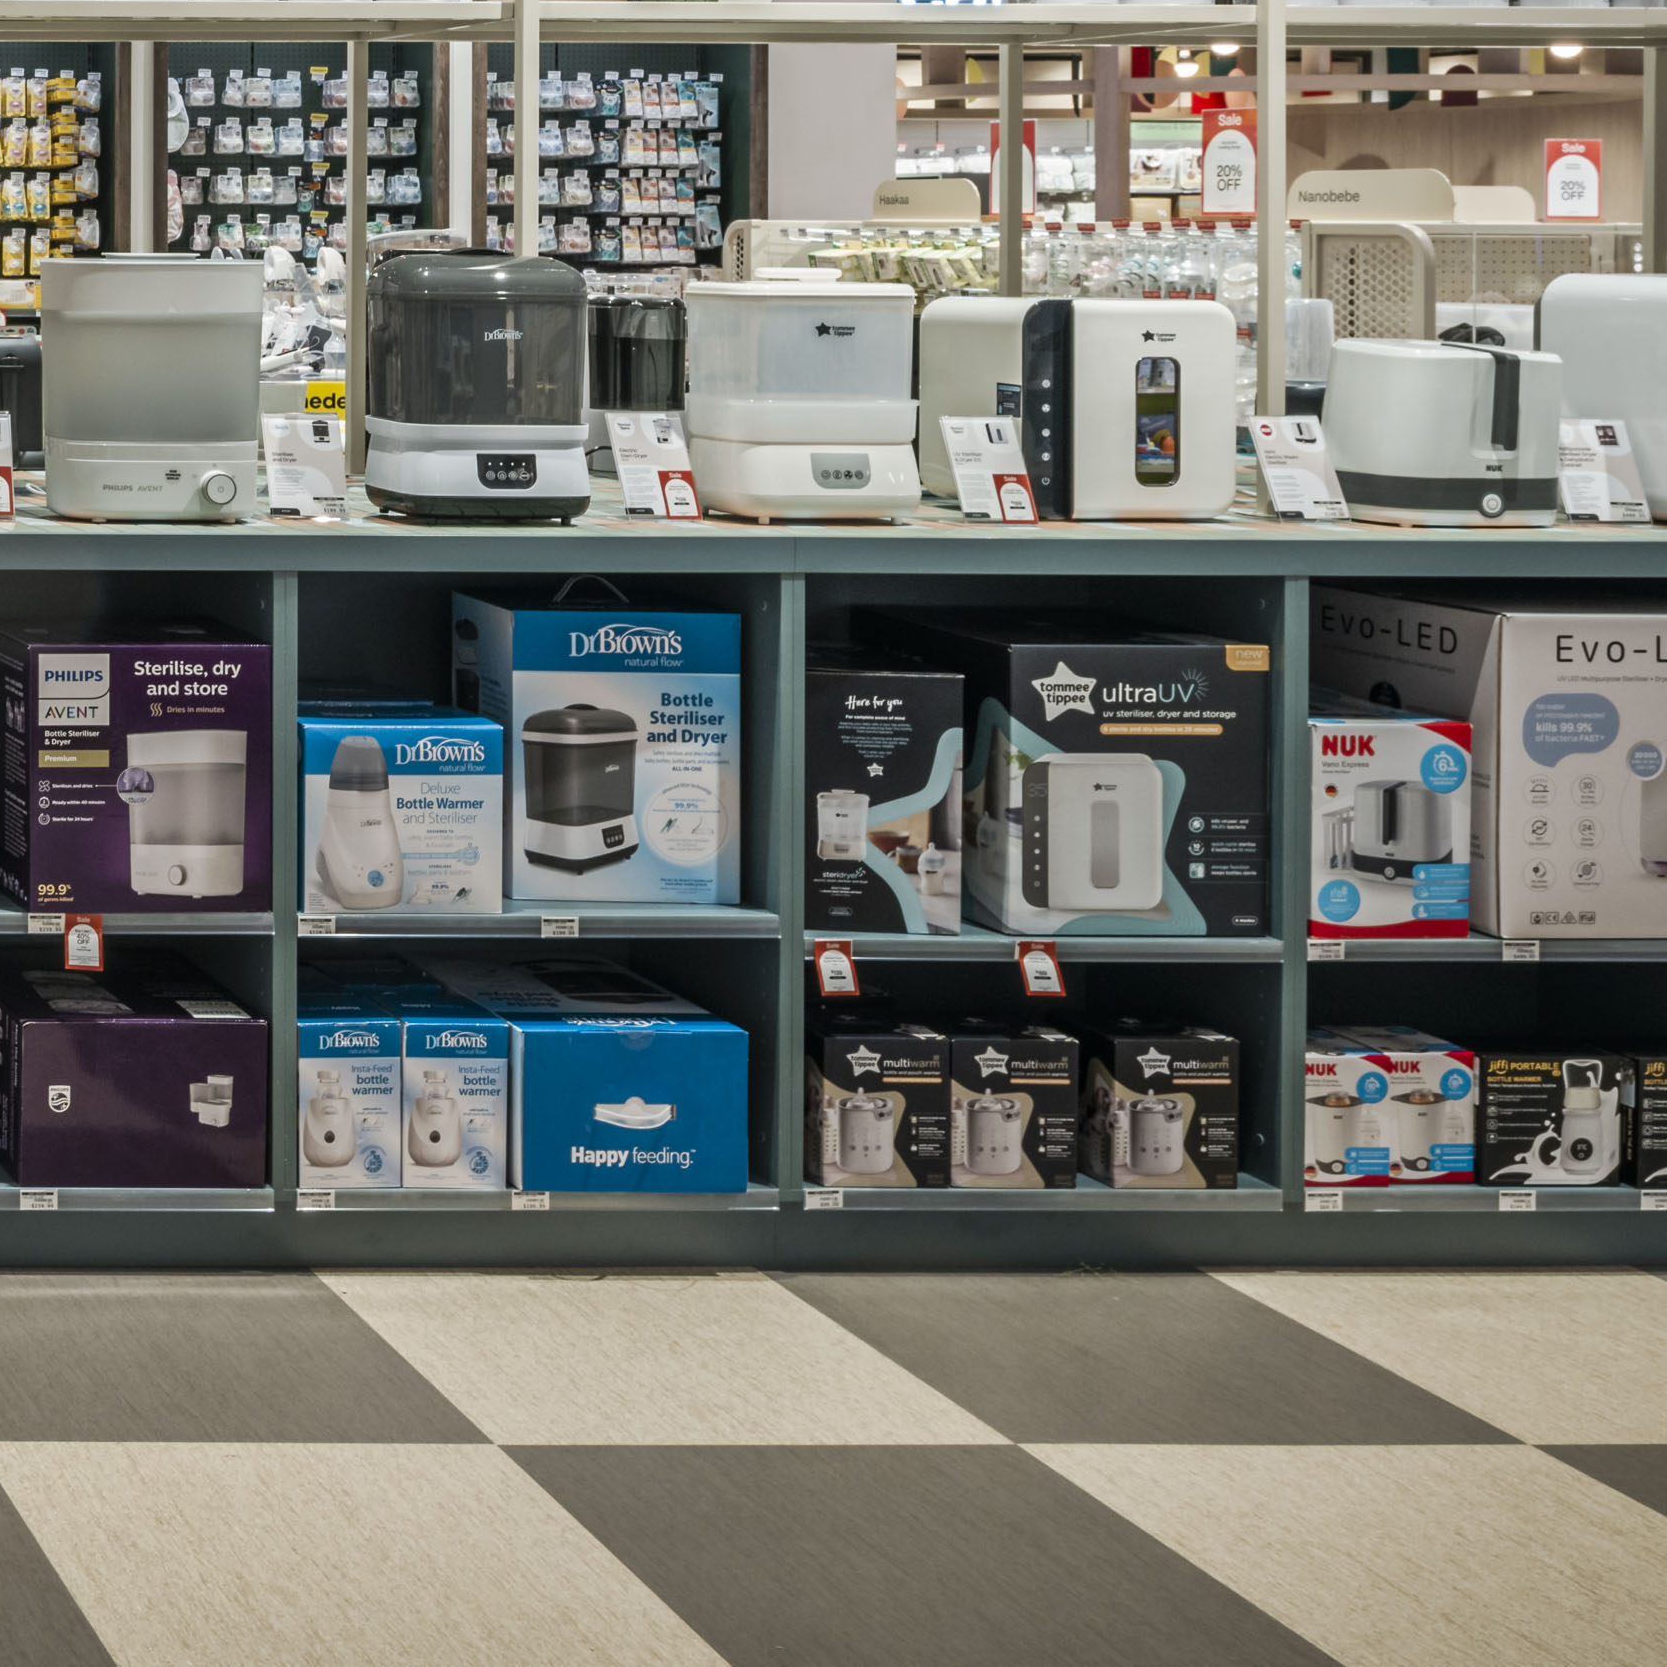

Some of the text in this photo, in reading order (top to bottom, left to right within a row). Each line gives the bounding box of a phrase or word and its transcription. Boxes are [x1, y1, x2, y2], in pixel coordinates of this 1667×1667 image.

[1218, 114, 1241, 126] Sale
[1561, 143, 1585, 153] Sale
[1217, 165, 1242, 177] 20%
[1218, 179, 1241, 191] OFF
[1560, 181, 1585, 190] 20%
[879, 194, 909, 205] Haakaa
[1299, 190, 1360, 202] Nanobebe
[1561, 191, 1584, 200] OFF
[102, 484, 133, 492] PHILIPS
[1321, 605, 1458, 655] Evo-LED
[1236, 649, 1263, 659] new
[624, 656, 683, 668] natural flow
[134, 661, 241, 678] Sterilise, dry
[45, 670, 103, 682] PHILIPS
[147, 682, 228, 696] and store
[1040, 683, 1089, 693] tommee
[1103, 683, 1195, 703] ultraUV
[661, 693, 713, 707] Bottle
[845, 695, 903, 711] Here for you
[1046, 692, 1086, 706] tippee
[45, 706, 99, 719] AVENT
[195, 706, 225, 714] minutes
[1116, 710, 1155, 719] steriliser,
[1157, 710, 1180, 719] dryer
[1183, 710, 1200, 718] and
[1202, 710, 1236, 720] storage
[650, 711, 725, 726] Steriliser
[1536, 722, 1592, 733] kills 99.9%
[44, 738, 71, 746] & Dryer
[646, 729, 727, 747] and Dryer
[1322, 735, 1375, 757] NUK
[439, 763, 485, 772] natural flow
[420, 782, 461, 794] Deluxe
[396, 798, 484, 809] Bottle Warmer
[403, 813, 477, 824] and Steriliser
[38, 884, 71, 896] 99.9%
[76, 916, 91, 924] Sale
[884, 1058, 940, 1068] multiwarm
[1011, 1060, 1068, 1069] multiwarm
[1173, 1060, 1229, 1069] multiwarm
[1389, 1061, 1422, 1073] NUK
[1510, 1062, 1559, 1071] PORTABLE
[351, 1065, 392, 1073] Insta-Feed
[458, 1066, 500, 1074] Insta-Feed
[1305, 1063, 1337, 1076] NUK
[357, 1075, 389, 1085] bottle
[463, 1075, 496, 1085] bottle
[352, 1086, 394, 1096] warmer
[459, 1088, 501, 1097] warmer
[571, 1146, 629, 1167] Happy
